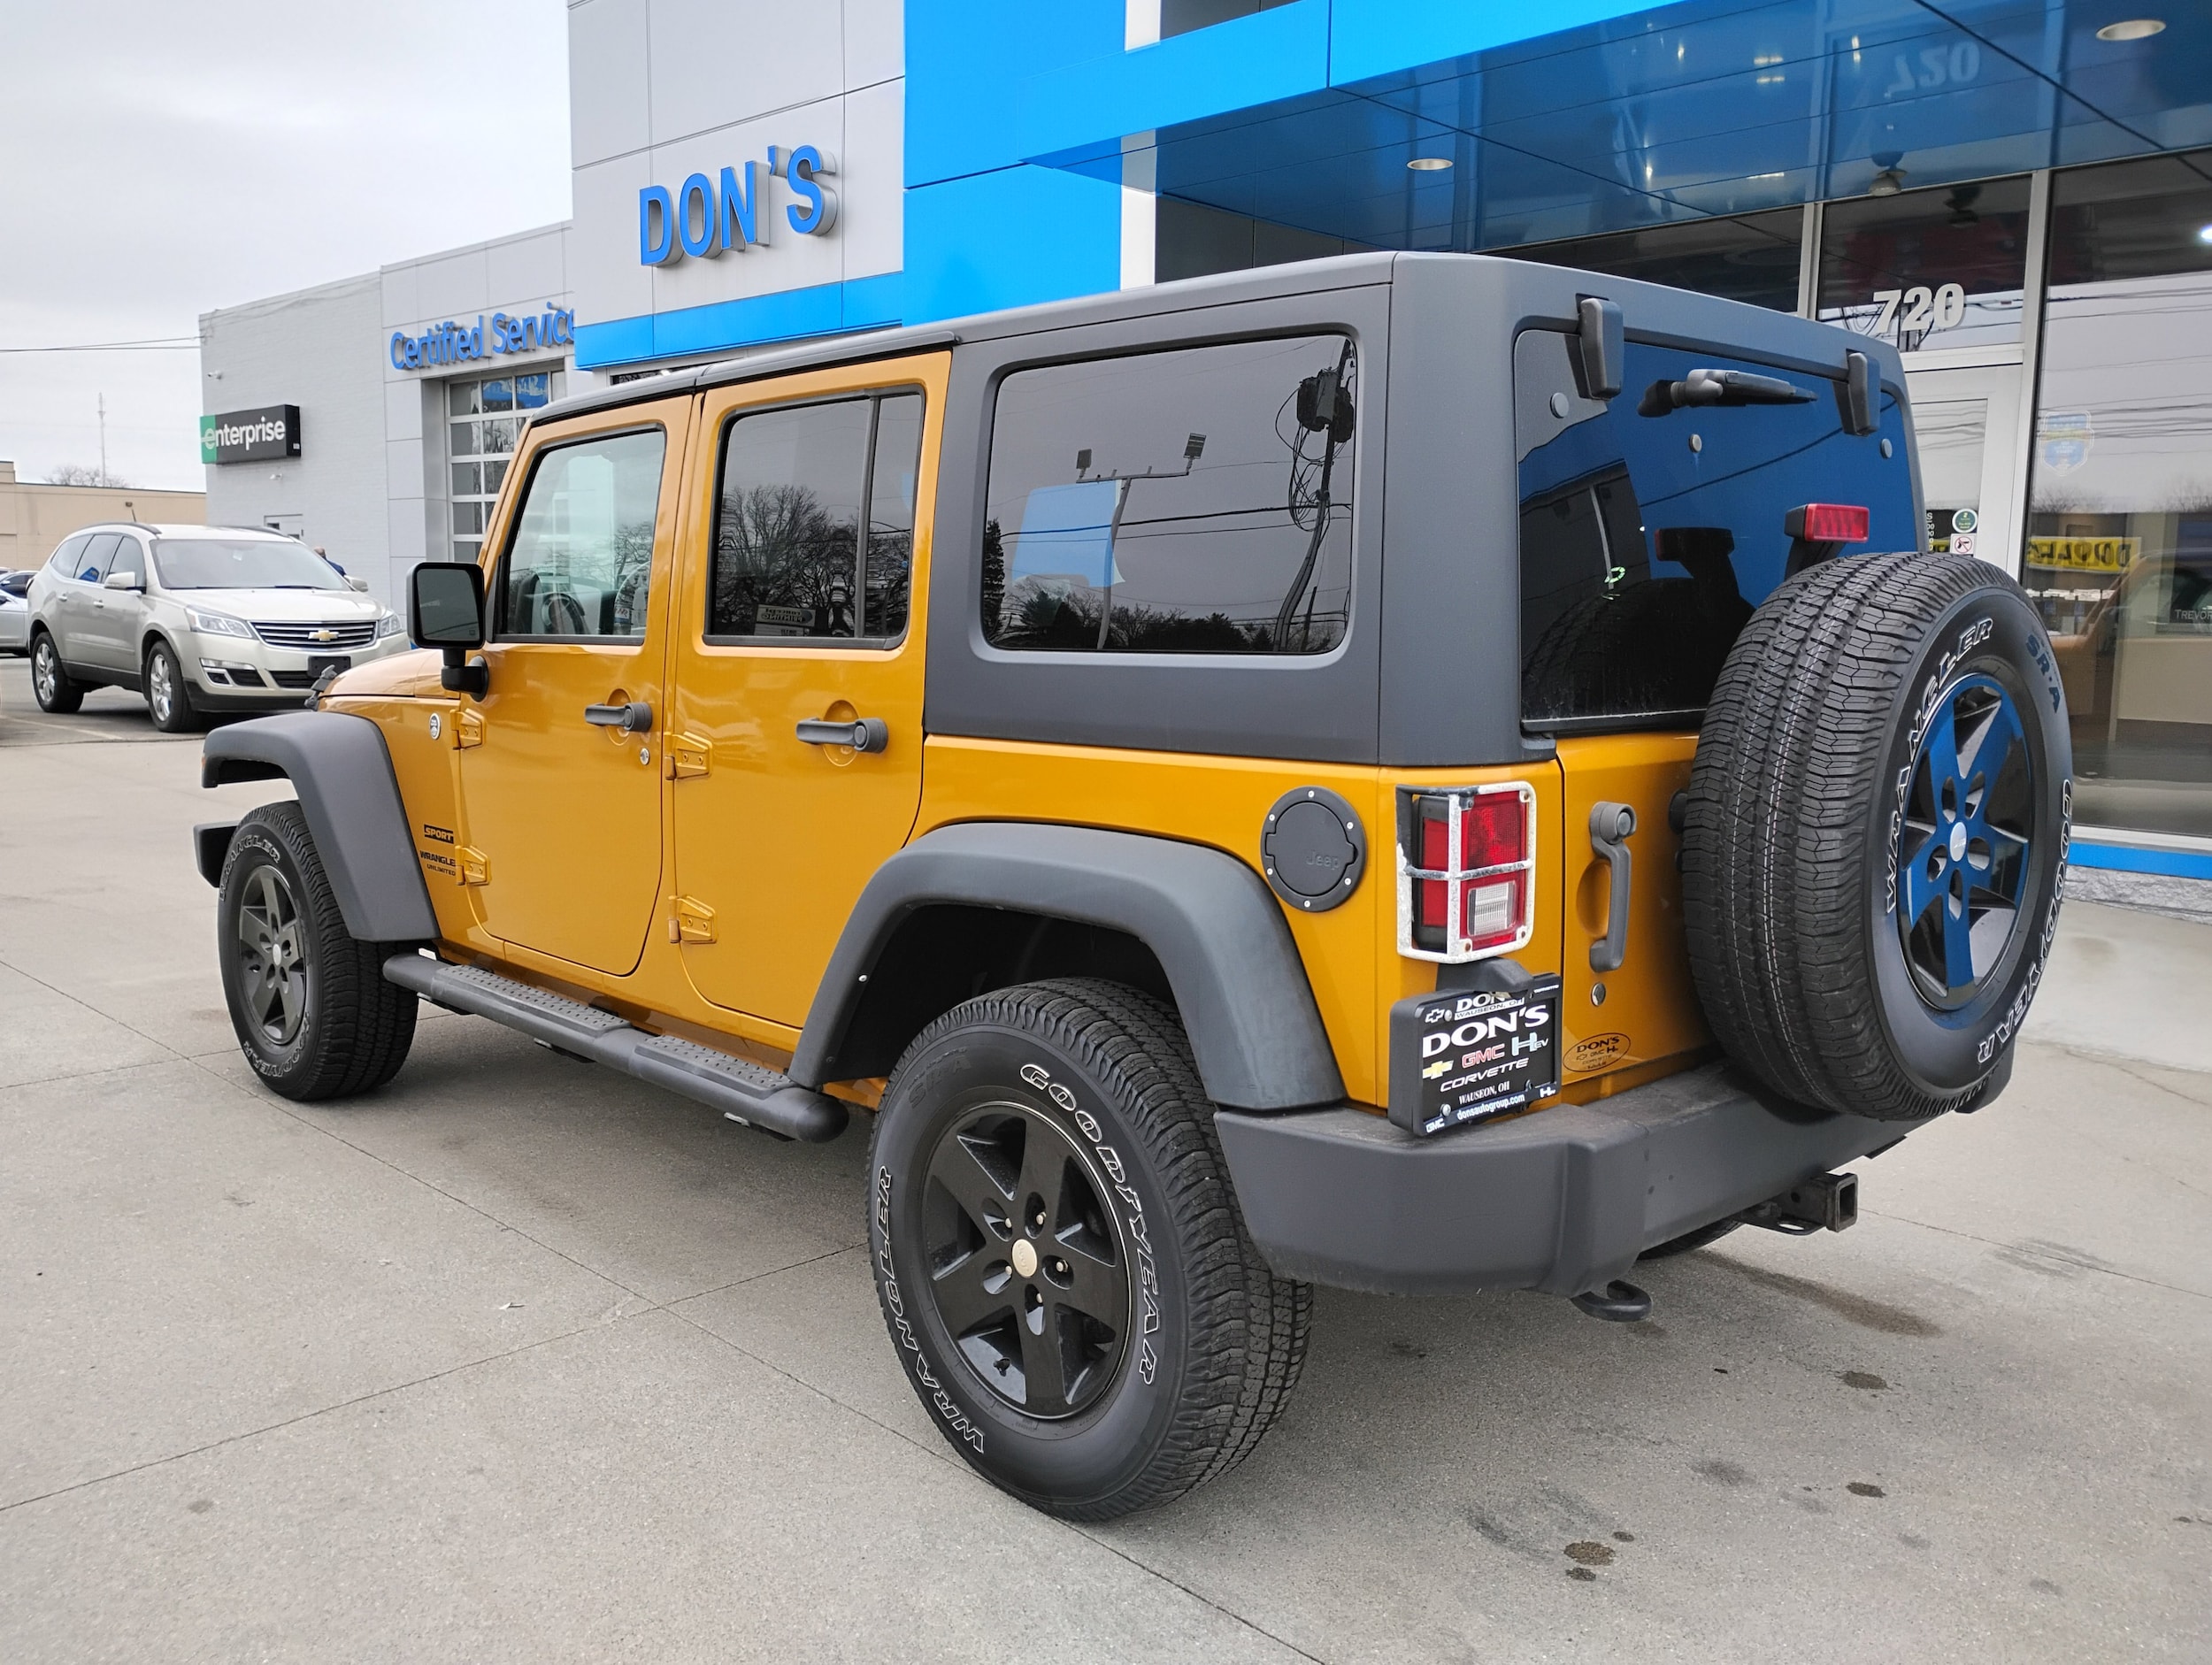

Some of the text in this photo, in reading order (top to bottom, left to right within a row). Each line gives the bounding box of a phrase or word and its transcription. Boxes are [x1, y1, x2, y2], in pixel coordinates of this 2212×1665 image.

[639, 144, 833, 266] DON'S
[1872, 283, 1965, 334] 720
[389, 314, 484, 370] Certified
[203, 415, 286, 451] enterprise
[1886, 618, 1993, 914] WRANGLER
[425, 826, 453, 841] SPORT
[419, 849, 457, 867] WRANGLE
[1977, 779, 2073, 1065] GOODYEAR
[1422, 1004, 1549, 1059] DON'S
[1576, 1036, 1620, 1054] DON'S
[1440, 1057, 1530, 1093] CORVETTE
[1462, 1043, 1505, 1068] GMC
[1425, 1117, 1445, 1133] GMC
[1456, 1093, 1525, 1121] donsautogroup.com
[1459, 1080, 1510, 1105] WAUSEON, OH
[1019, 1063, 1161, 1385] GOODYEAR
[876, 1165, 986, 1454] WRANGLER
